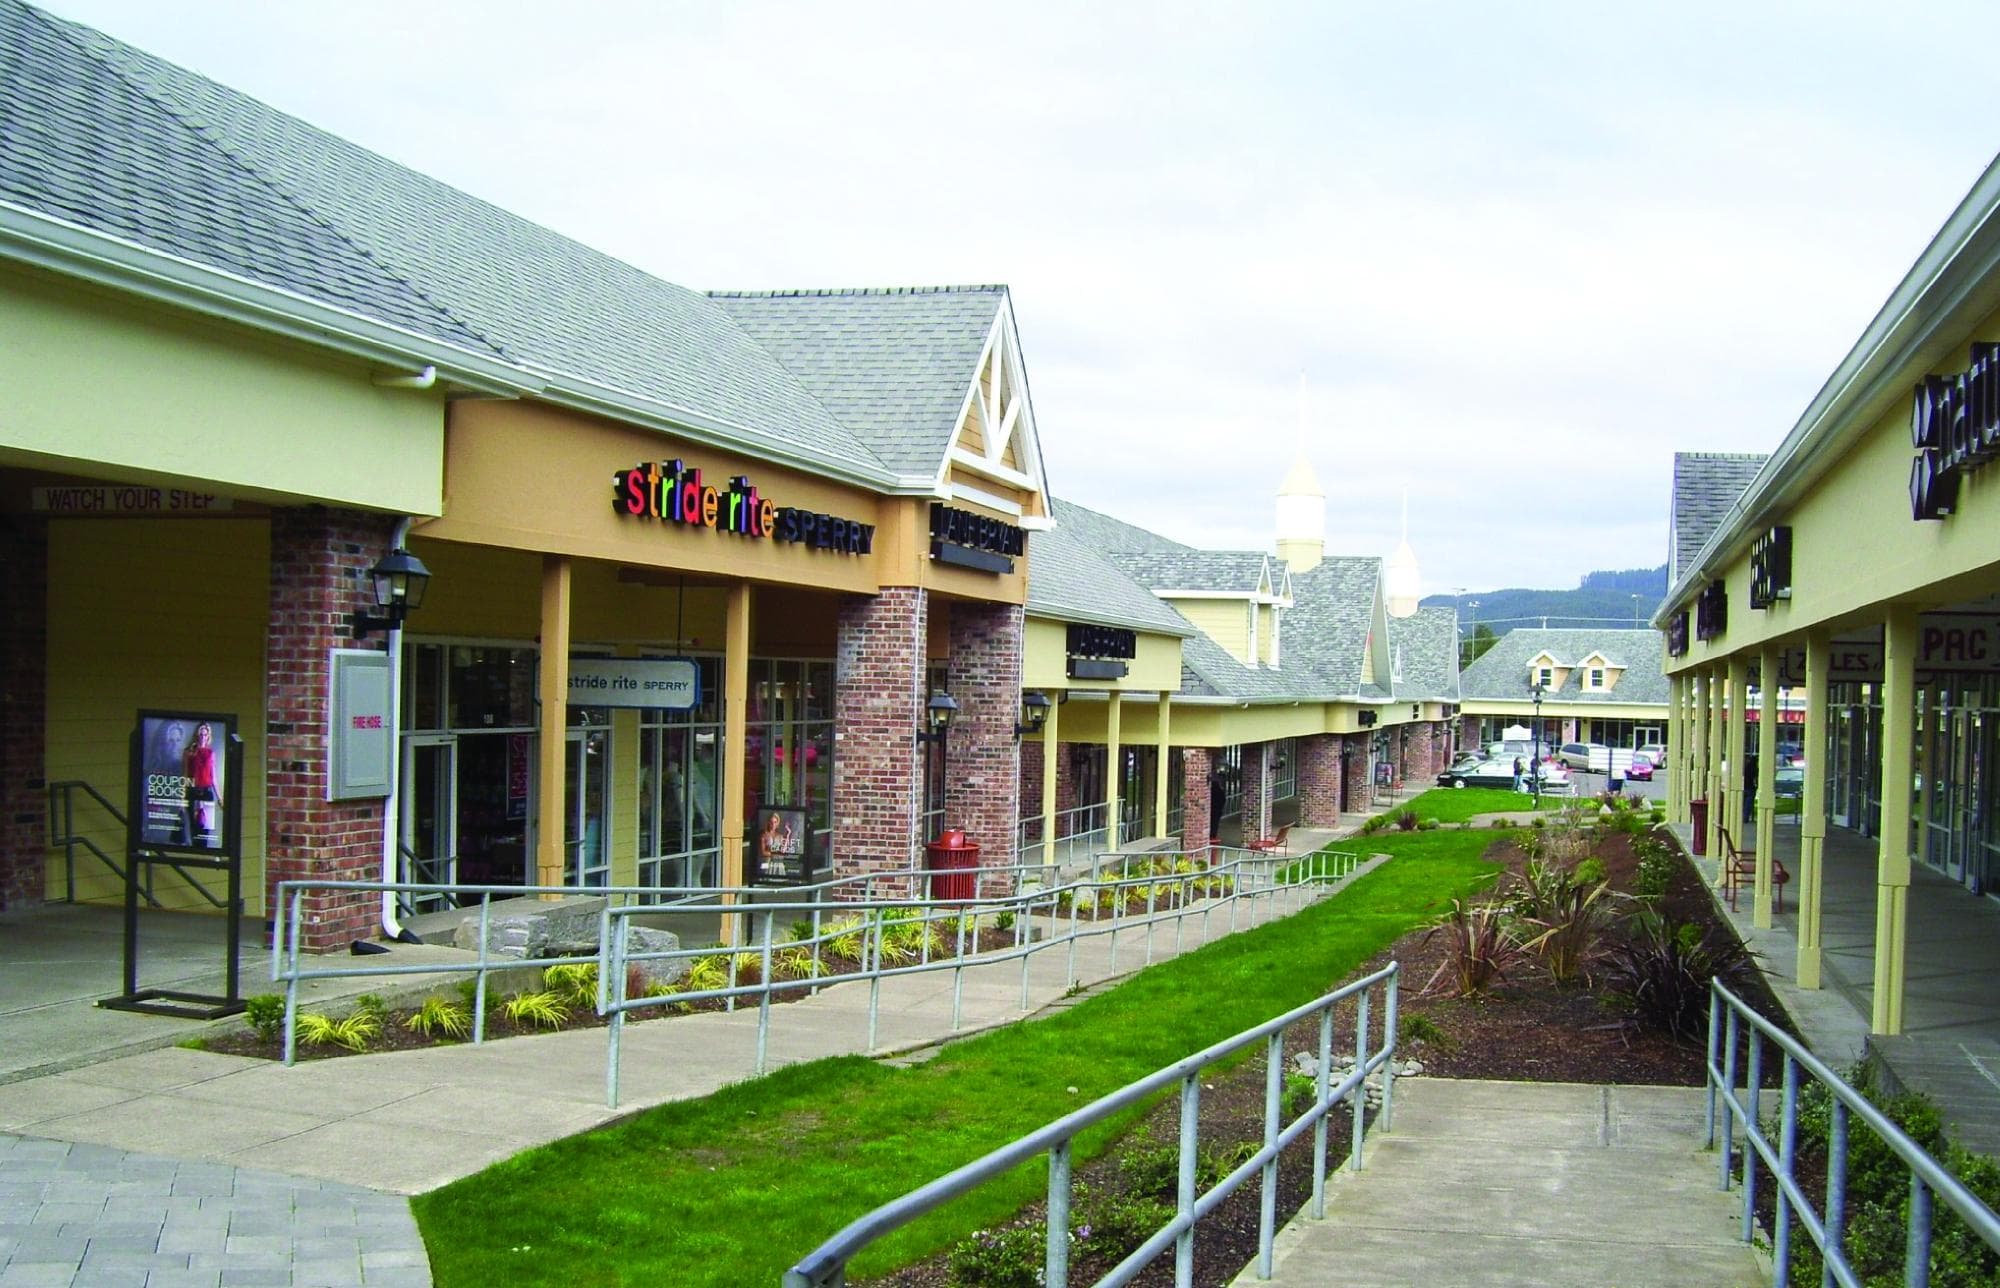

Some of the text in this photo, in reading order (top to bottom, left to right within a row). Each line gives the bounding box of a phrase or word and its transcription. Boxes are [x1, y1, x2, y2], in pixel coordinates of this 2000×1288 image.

[46, 488, 215, 511] WATCH YOUR STEP
[619, 458, 876, 555] stride rite SPERRY
[567, 674, 689, 692] stride rite SPERRY
[352, 715, 382, 729] FIRE HOSE
[148, 774, 196, 788] COUPON
[148, 785, 187, 799] BOOKS
